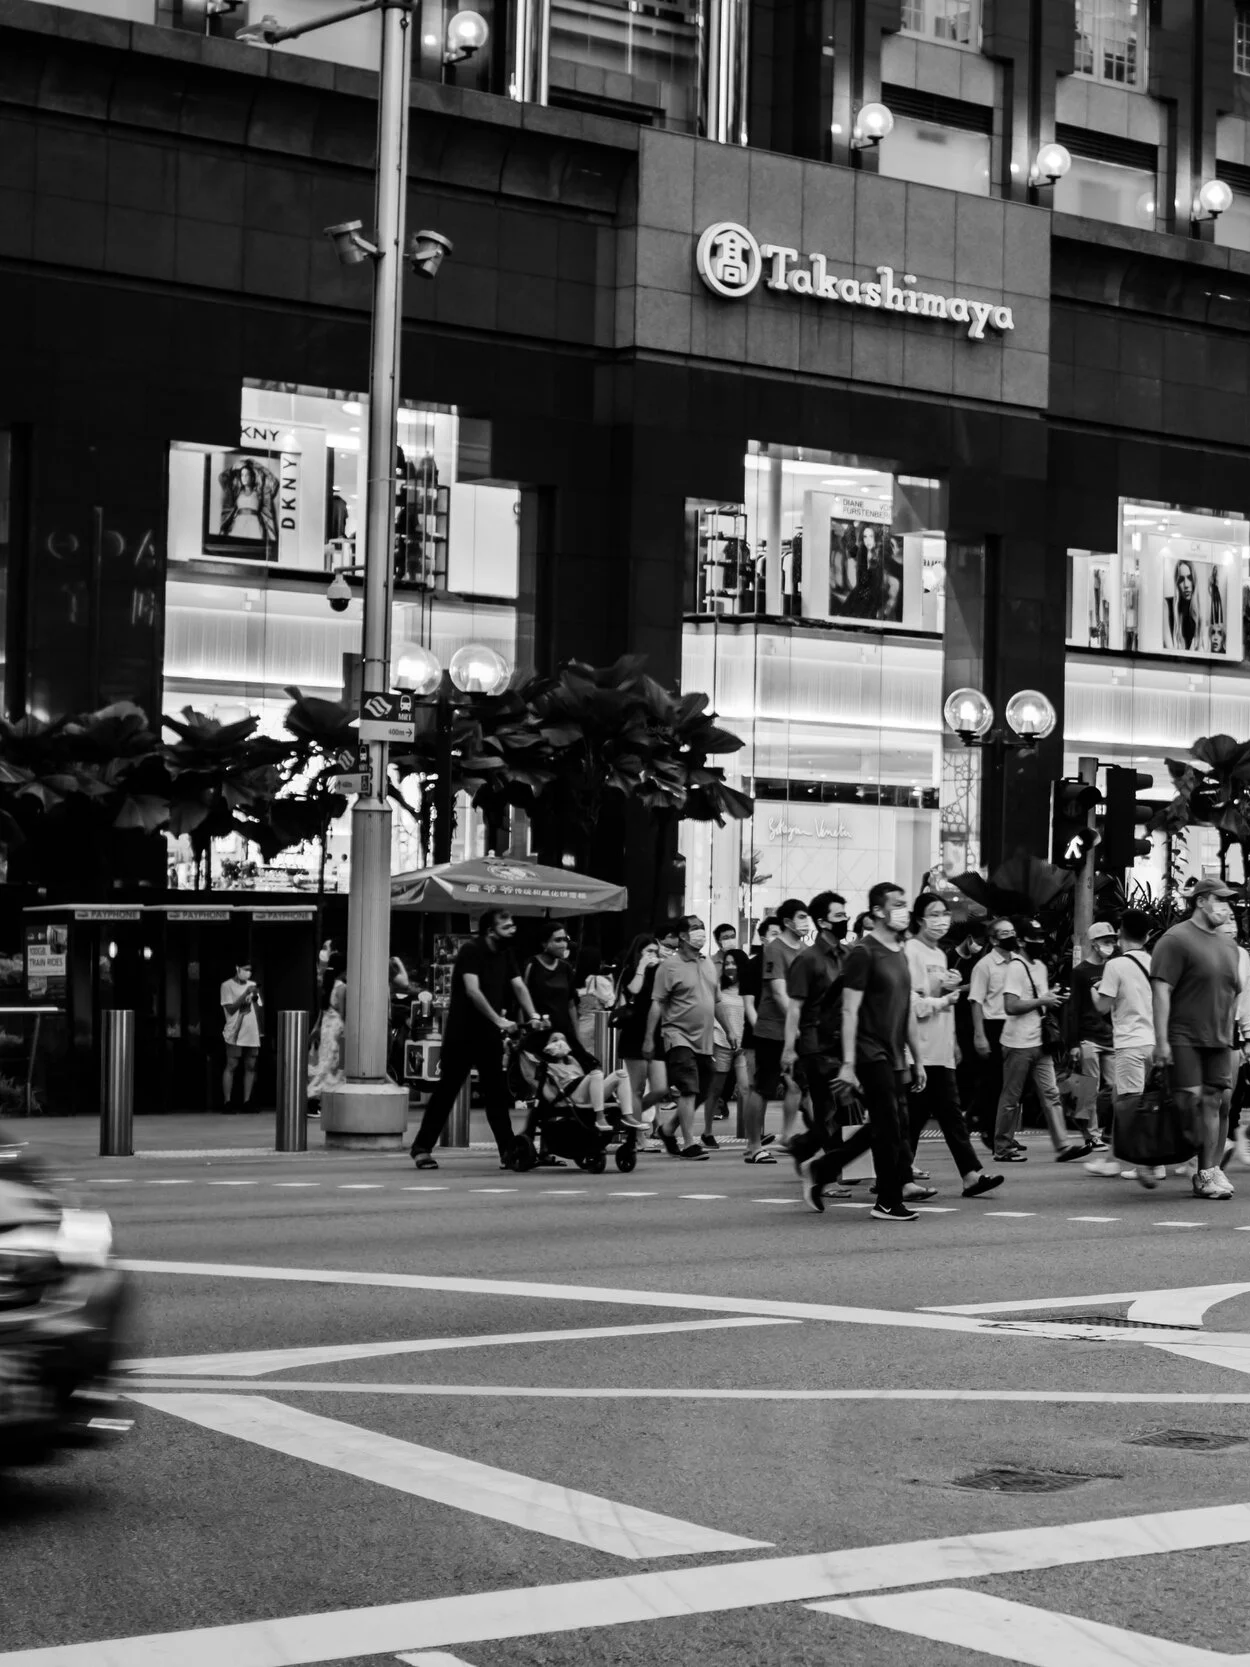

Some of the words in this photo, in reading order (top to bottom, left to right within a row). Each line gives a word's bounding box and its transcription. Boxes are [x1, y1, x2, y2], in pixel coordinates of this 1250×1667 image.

[760, 243, 1015, 340] Takashimaya
[281, 457, 297, 530] DKNY
[843, 499, 864, 508] DIANE
